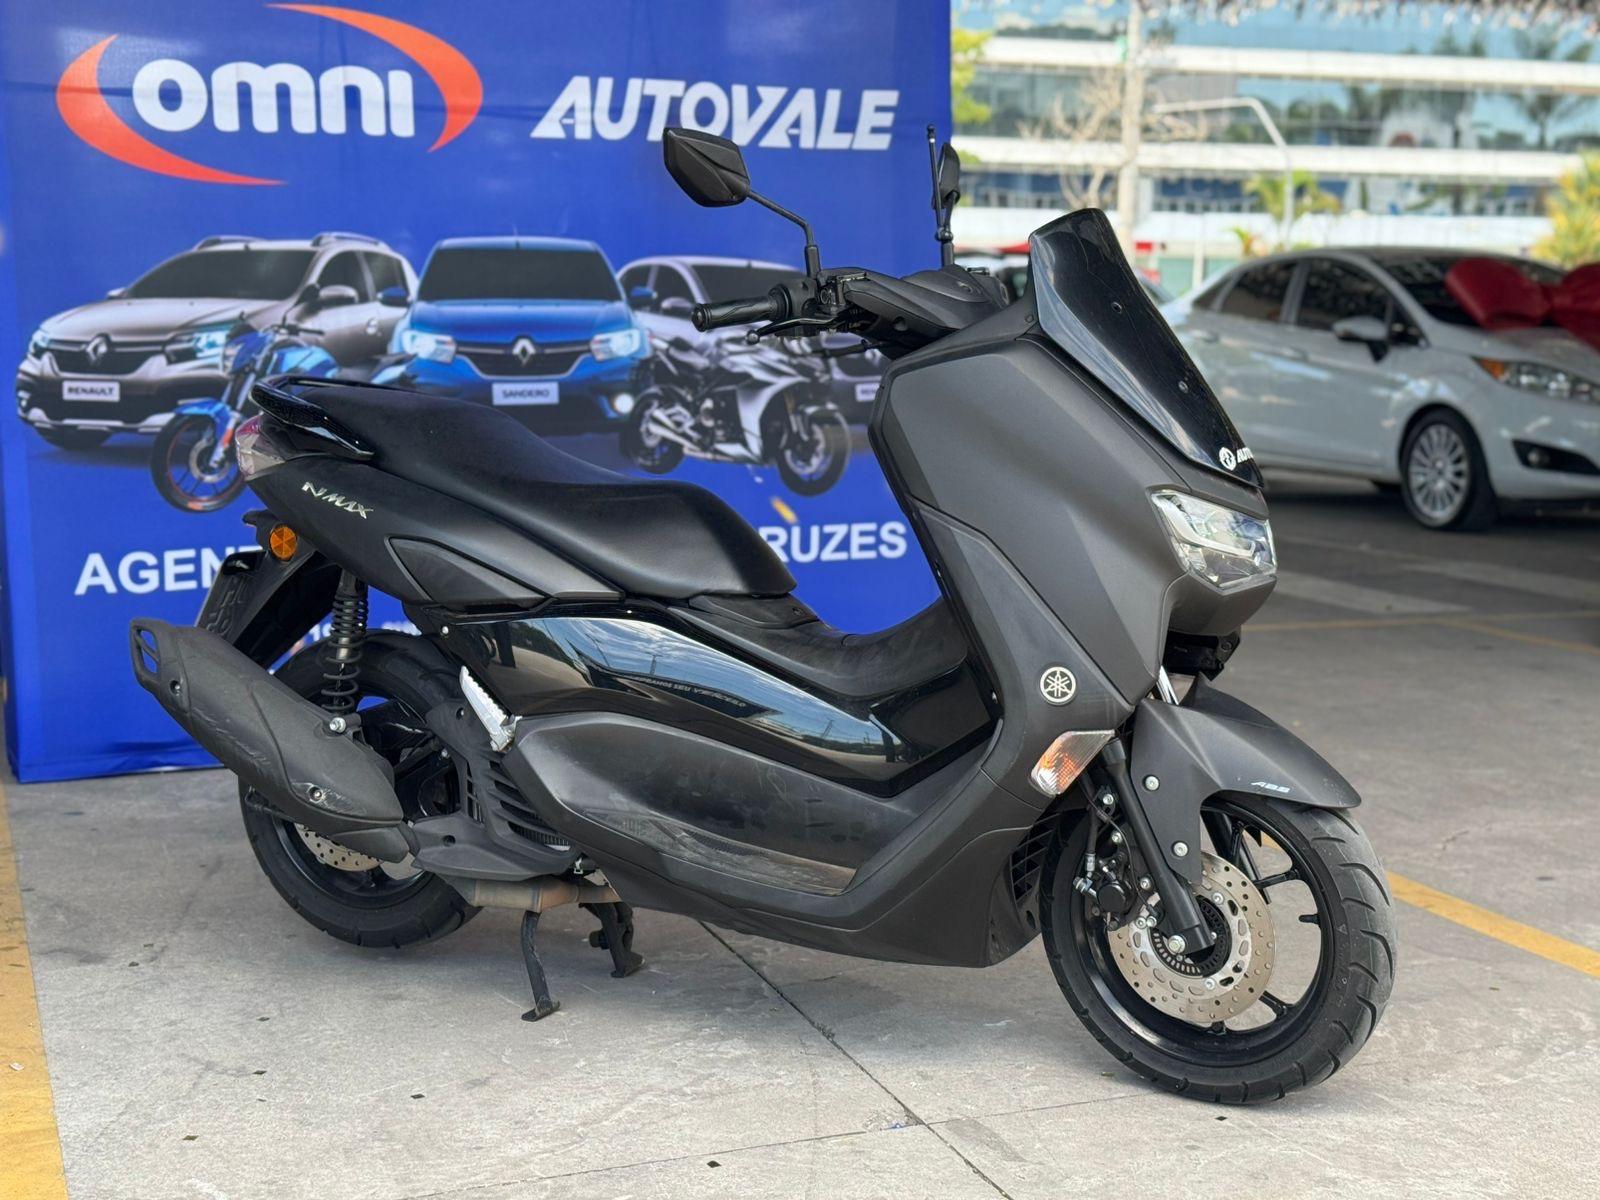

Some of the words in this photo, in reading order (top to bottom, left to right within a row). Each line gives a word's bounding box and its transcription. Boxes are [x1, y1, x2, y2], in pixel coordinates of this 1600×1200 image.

[530, 75, 899, 150] AUTOVALE
[67, 386, 114, 396] RENAULT
[501, 388, 550, 399] SANDERO
[301, 481, 374, 519] NMAX
[1250, 781, 1290, 793] ABS
